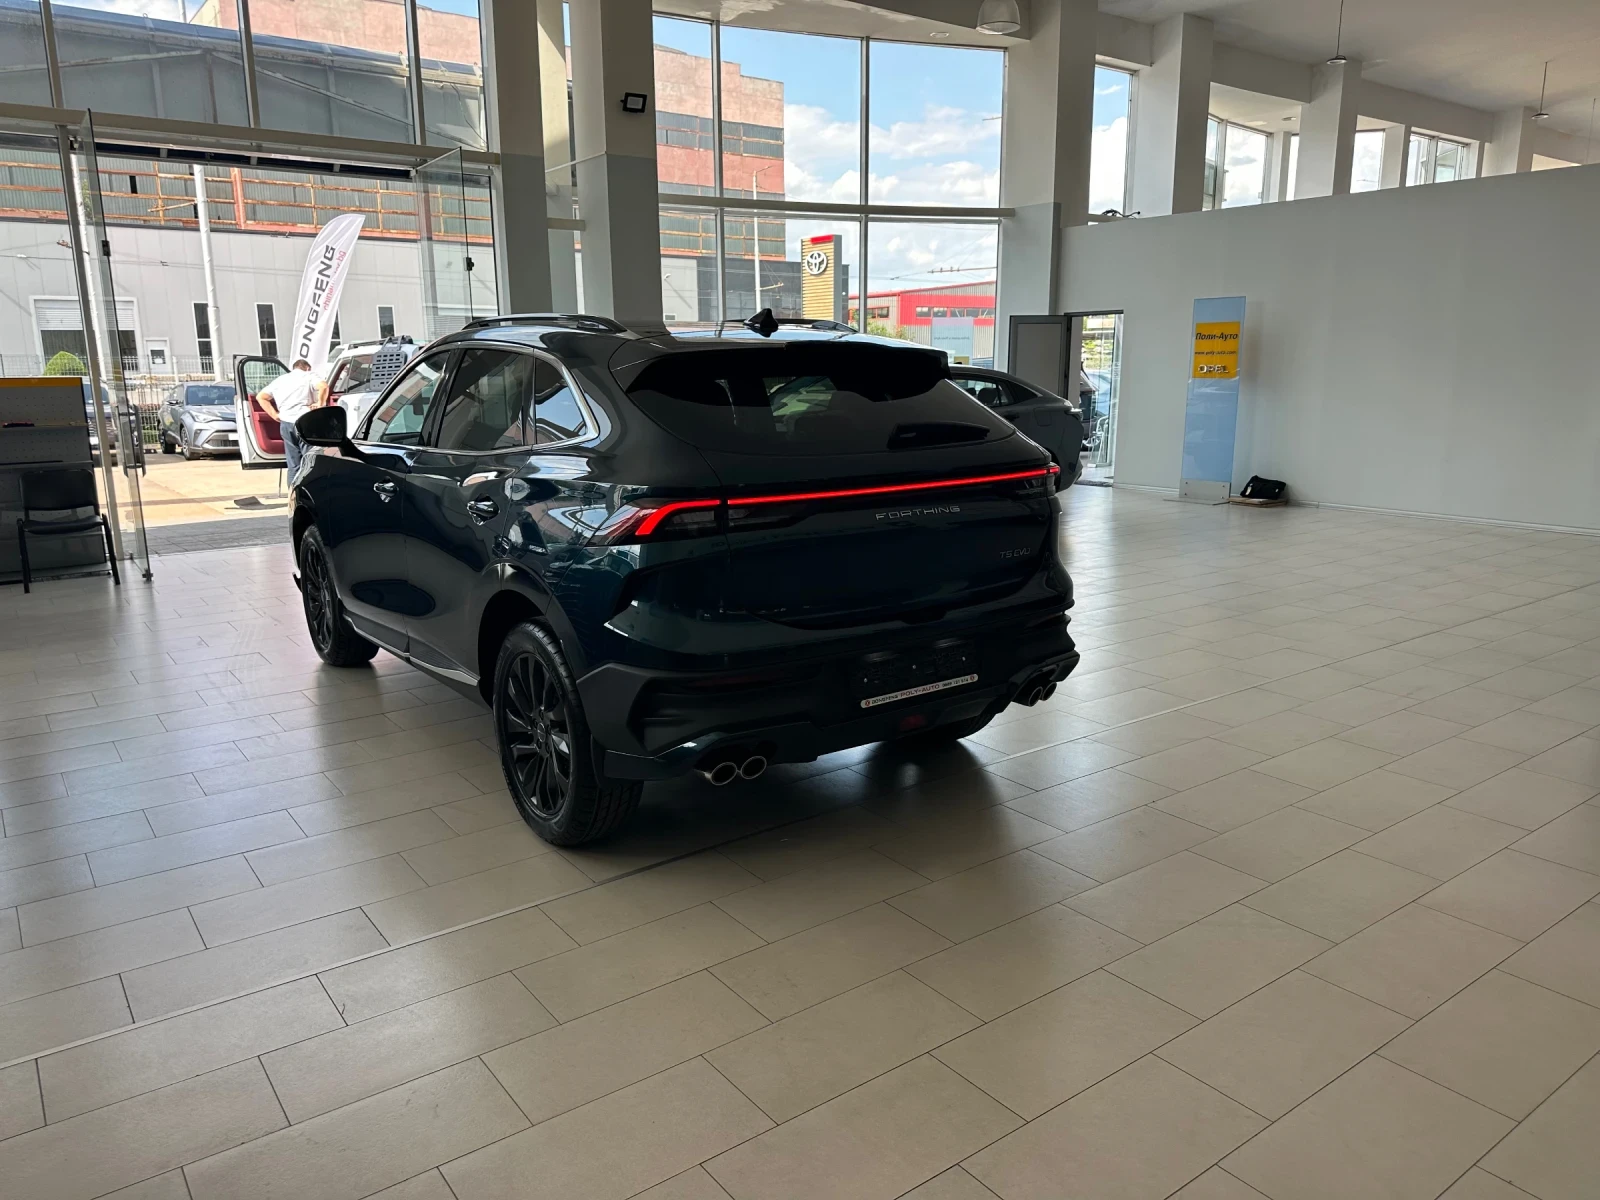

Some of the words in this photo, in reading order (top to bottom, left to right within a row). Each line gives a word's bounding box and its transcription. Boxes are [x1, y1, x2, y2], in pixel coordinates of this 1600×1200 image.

[300, 244, 336, 359] ONGFENG
[1195, 332, 1239, 341] Поли-Ауто
[1198, 364, 1229, 373] OPEL
[875, 505, 961, 520] FORTHING
[1000, 550, 1013, 559] T5
[900, 684, 940, 698] POLY-AUTO
